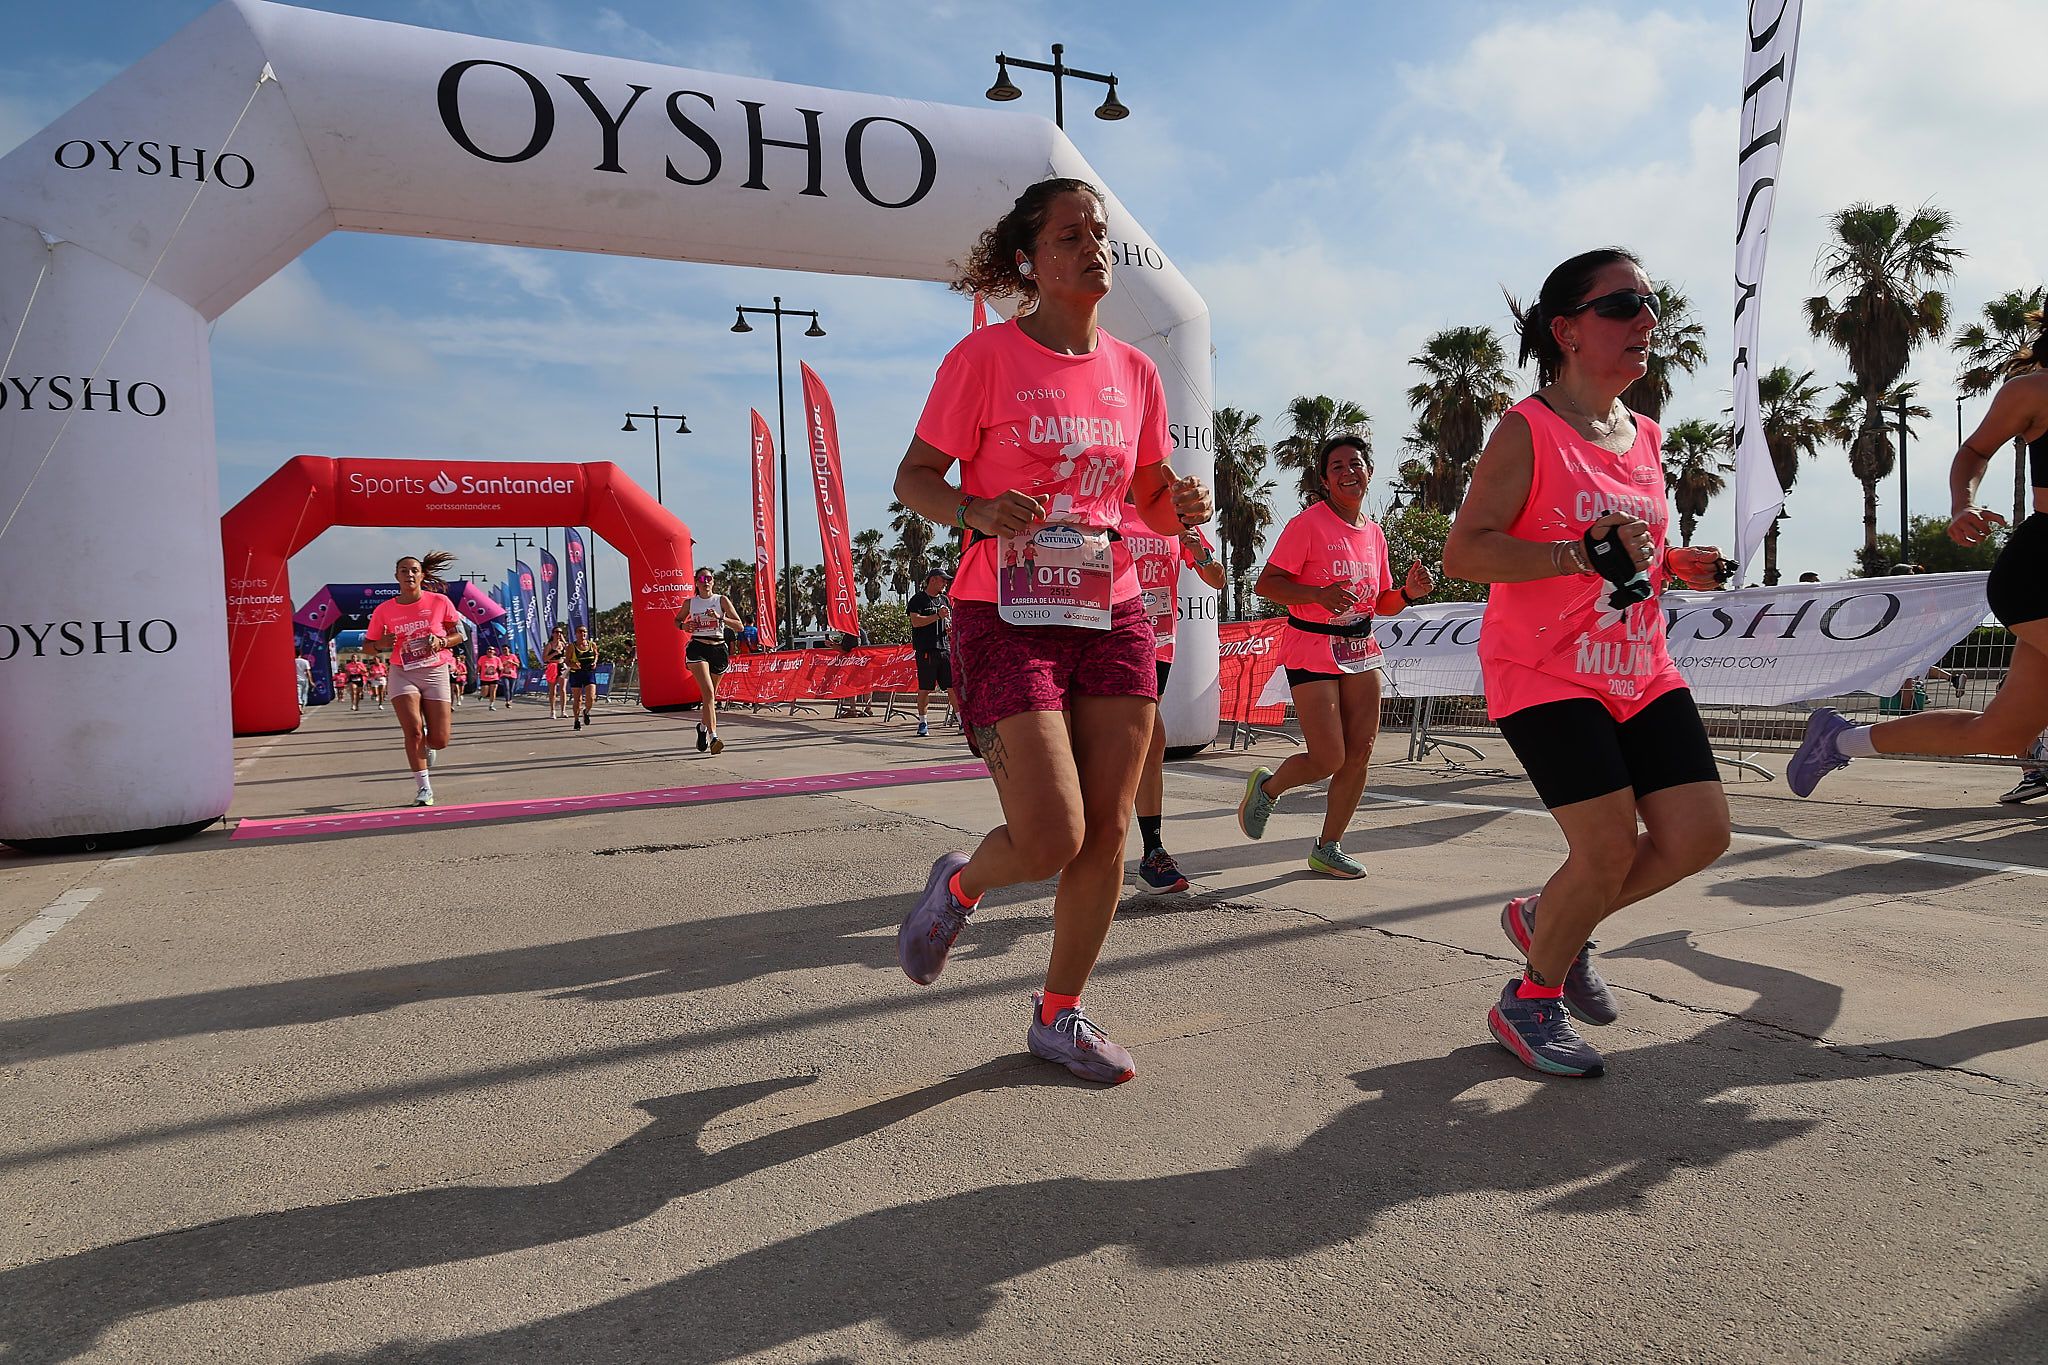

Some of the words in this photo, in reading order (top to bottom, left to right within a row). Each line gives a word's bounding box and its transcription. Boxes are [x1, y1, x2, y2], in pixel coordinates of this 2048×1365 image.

[437, 59, 937, 208] OYSHO
[54, 139, 255, 190] OYSHO
[1109, 240, 1163, 270] SHO
[0, 375, 167, 417] YSHO
[1016, 388, 1066, 402] OYSHO
[1028, 415, 1127, 449] CARRERA
[1168, 423, 1212, 452] SHO
[350, 473, 424, 498] Sports
[462, 476, 574, 494] Santander
[426, 503, 501, 511] sportssantander.es
[1037, 534, 1082, 545] ASTURIANA
[1128, 536, 1171, 556] RRERA
[654, 568, 683, 579] Sports
[1037, 566, 1081, 586] 016
[230, 579, 268, 590] Sports
[652, 583, 694, 592] Santande
[1050, 588, 1071, 597] 2515
[228, 595, 284, 605] Santander
[1056, 598, 1076, 606] MUJER
[1177, 595, 1216, 620] SHO
[1012, 610, 1051, 619] OYSHO
[1072, 613, 1100, 622] Santander
[1625, 603, 1647, 642] LA
[1666, 593, 1901, 641] YSHO
[1372, 619, 1480, 650] SHO
[1219, 636, 1274, 656] ander
[1351, 641, 1366, 650] 016
[1576, 642, 1653, 676] MUJER
[1673, 656, 1778, 669] .OYSHO.COM
[1608, 679, 1635, 697] 2026
